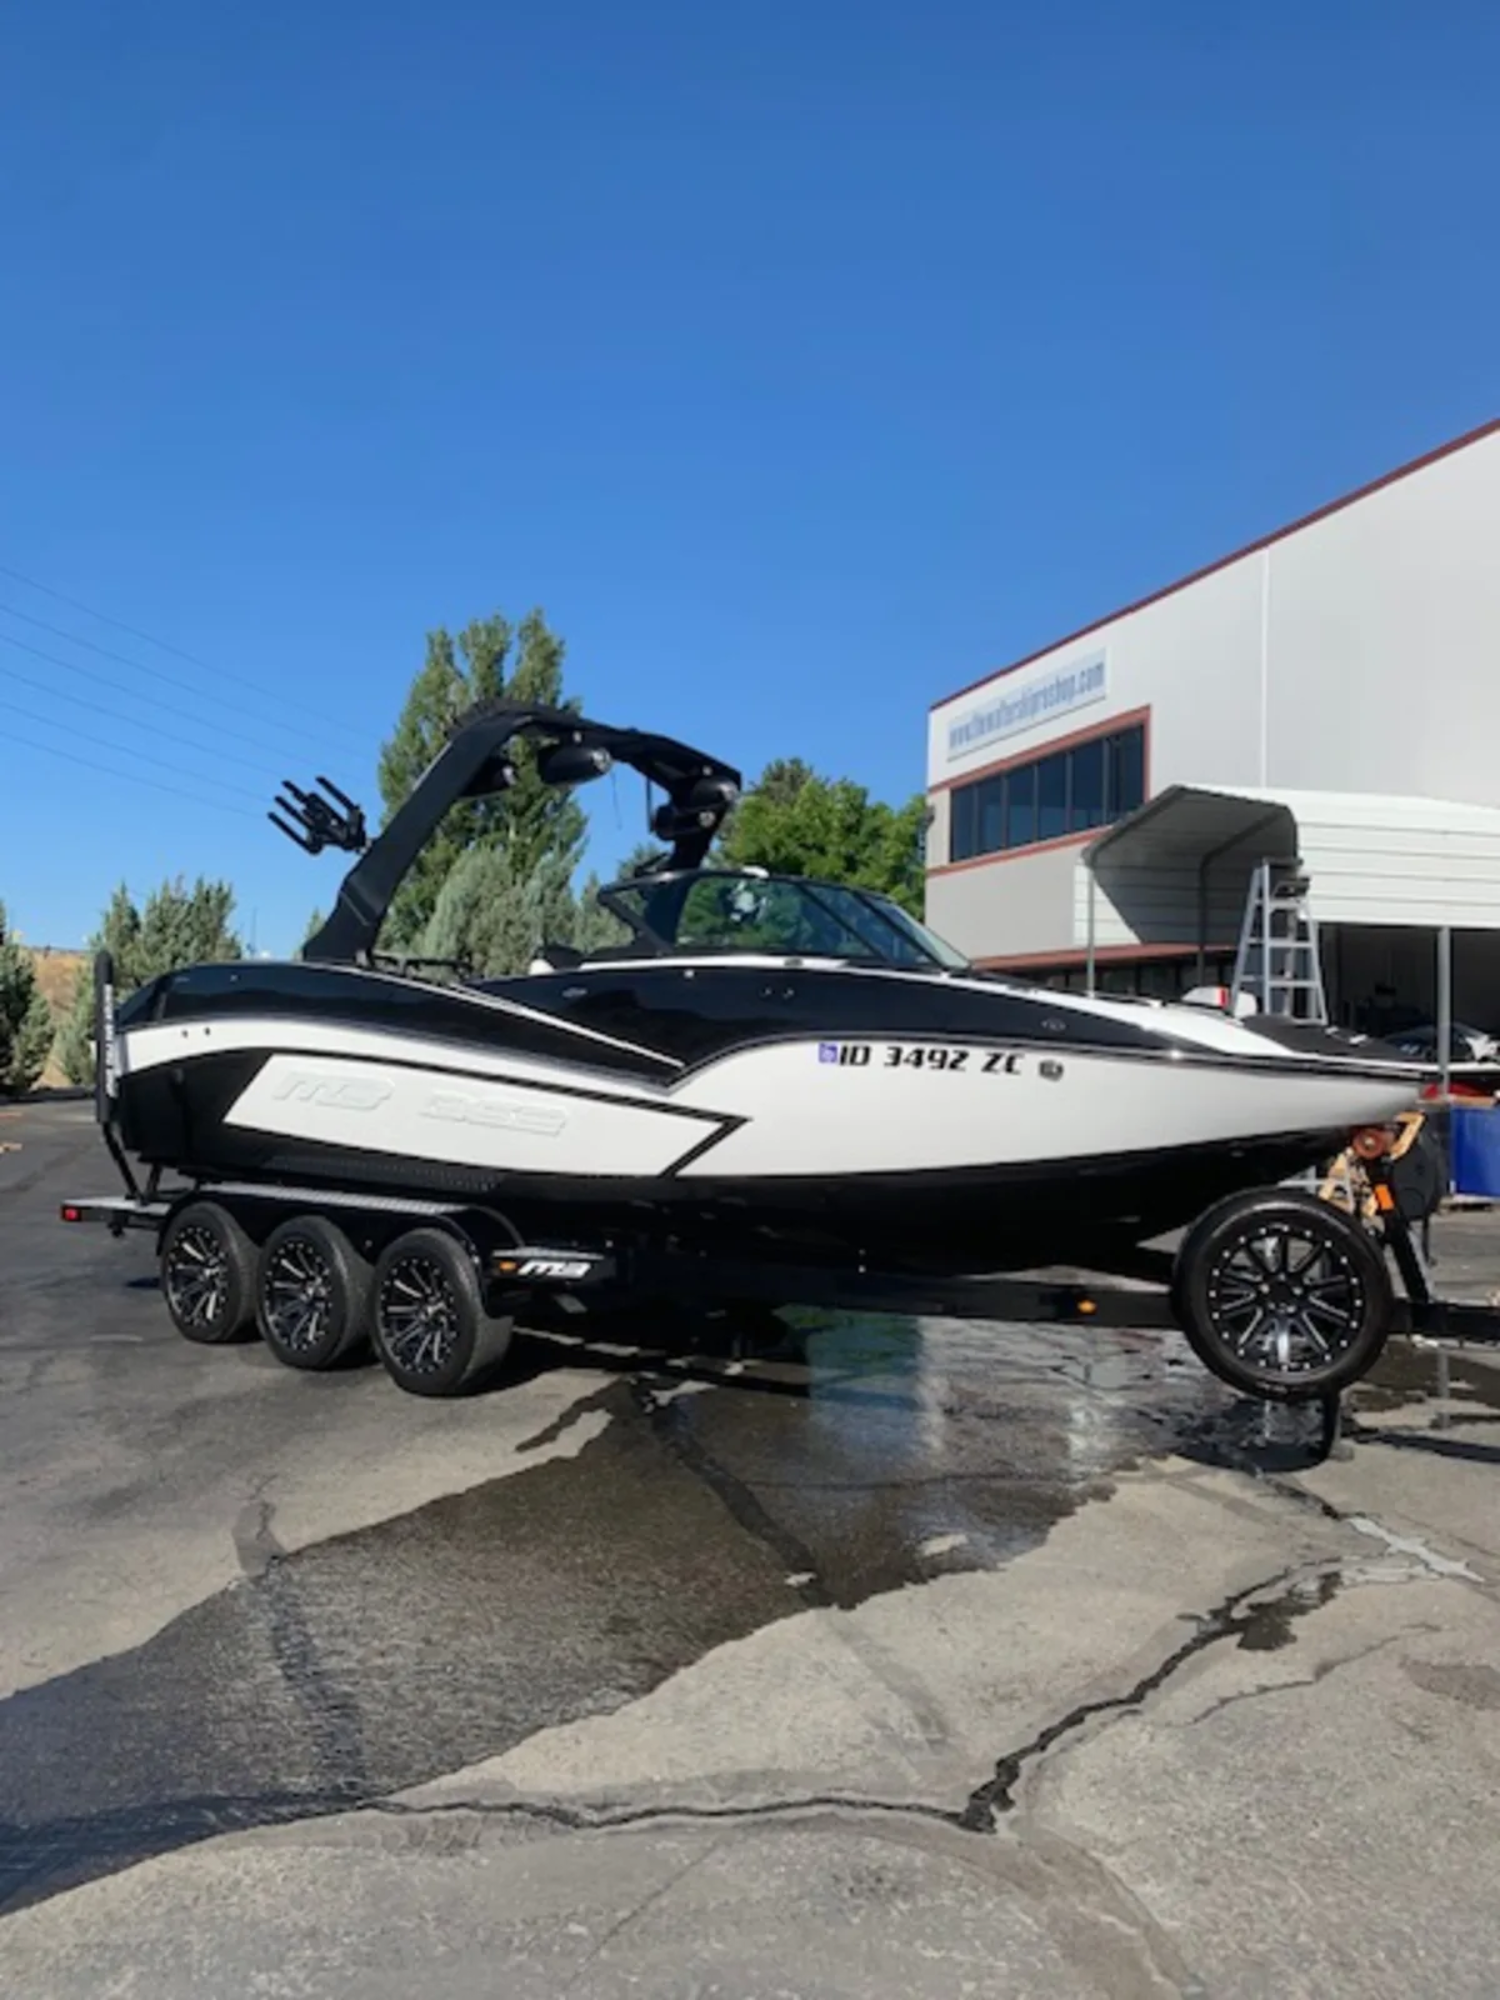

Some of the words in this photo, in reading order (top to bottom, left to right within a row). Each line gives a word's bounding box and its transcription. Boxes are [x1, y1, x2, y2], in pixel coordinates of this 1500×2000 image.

[839, 1045, 872, 1067] ID
[884, 1046, 970, 1072] 3492
[981, 1051, 1025, 1076] ZC
